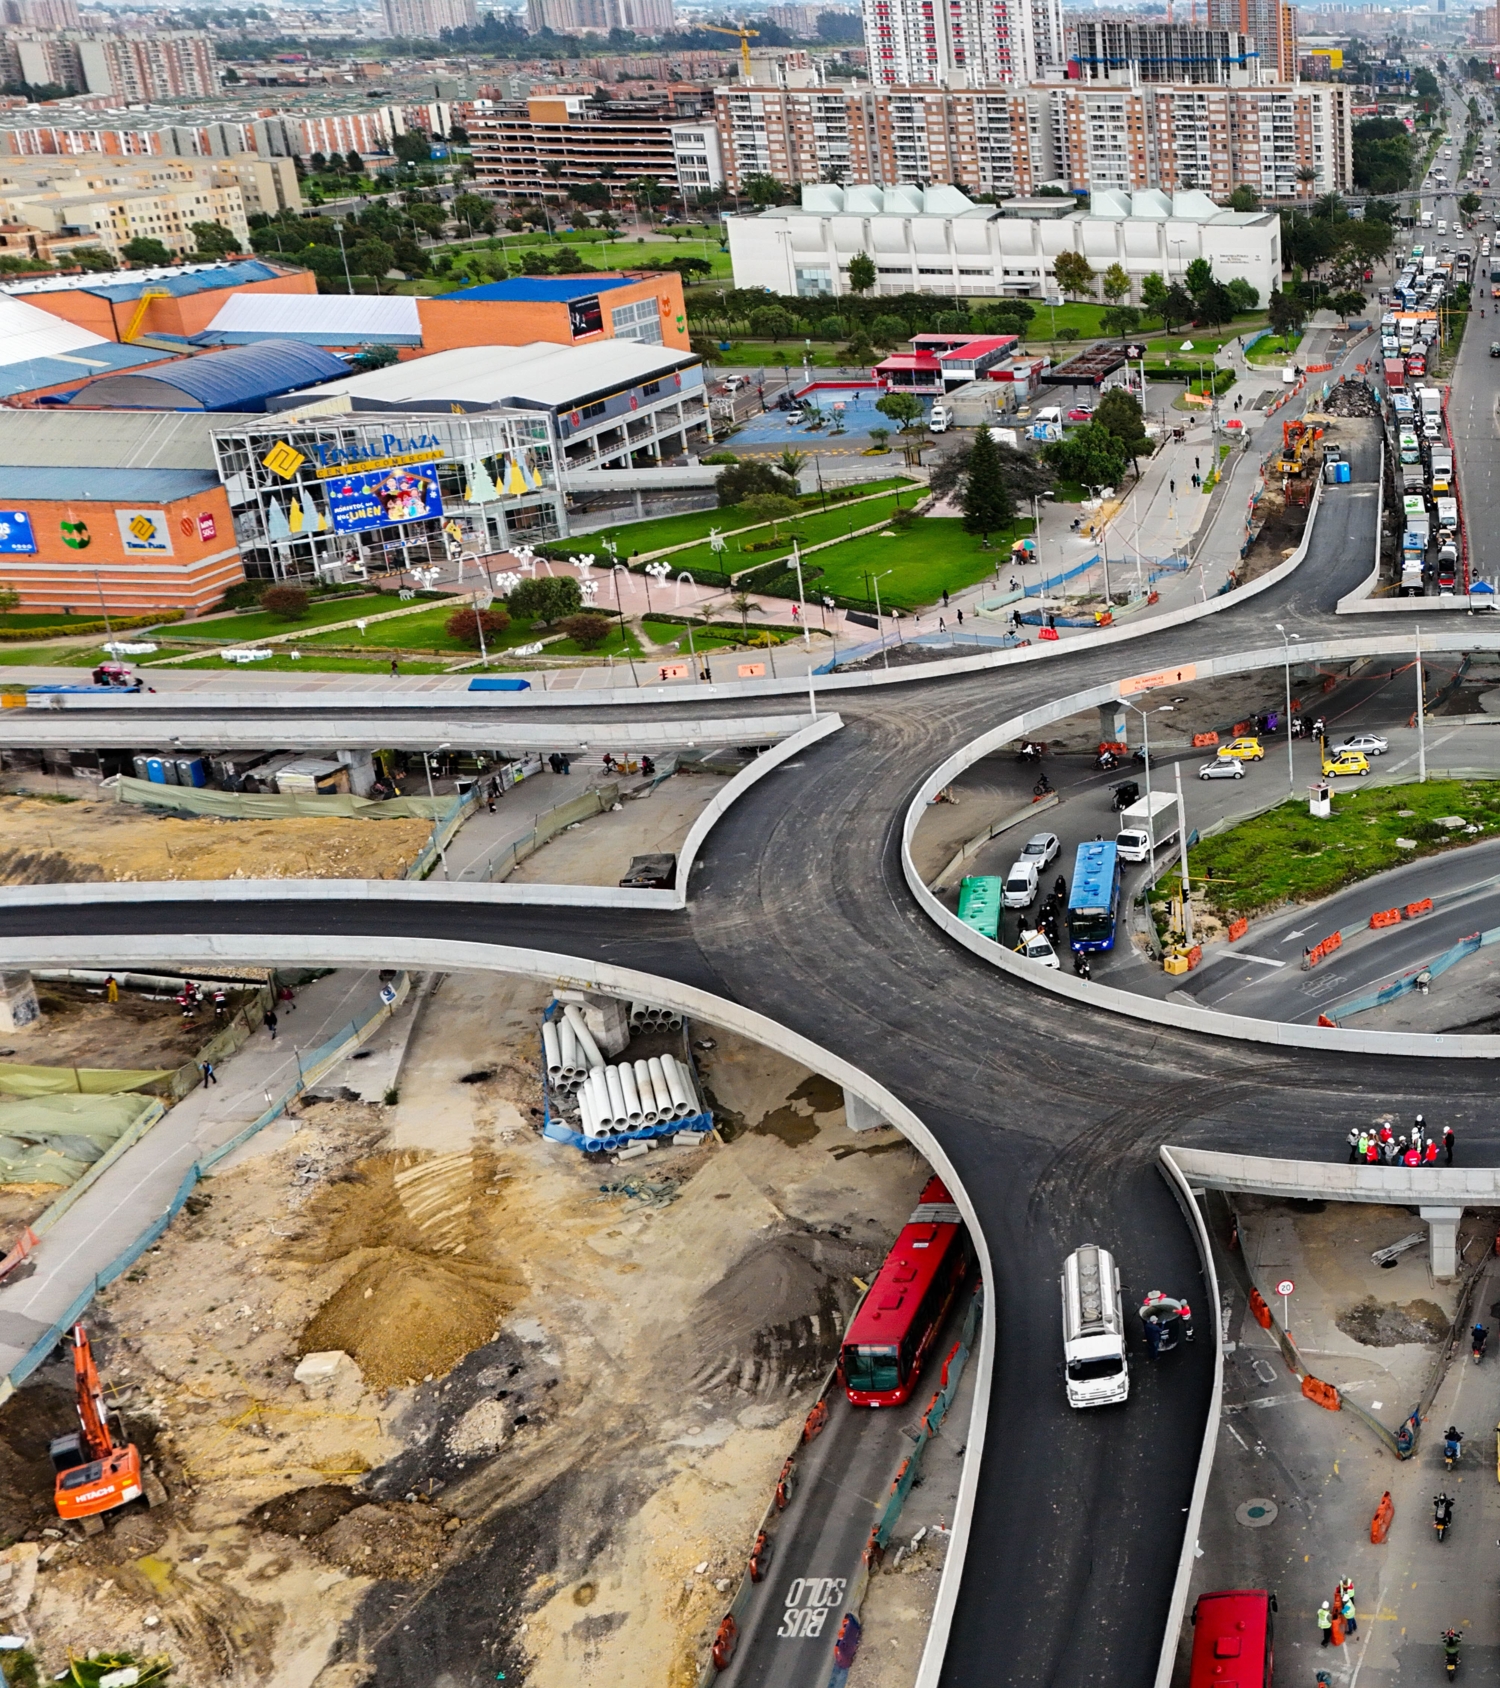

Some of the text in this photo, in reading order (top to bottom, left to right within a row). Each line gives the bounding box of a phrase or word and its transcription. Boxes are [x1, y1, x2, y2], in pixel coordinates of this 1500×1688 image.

[382, 433, 441, 456] PLAZA
[317, 450, 444, 477] CENTRO COMERCIAL
[349, 505, 382, 522] UNEN
[1281, 1284, 1291, 1292] 20
[75, 1485, 115, 1503] HITACHI
[776, 1577, 847, 1638] SOLO BUS
